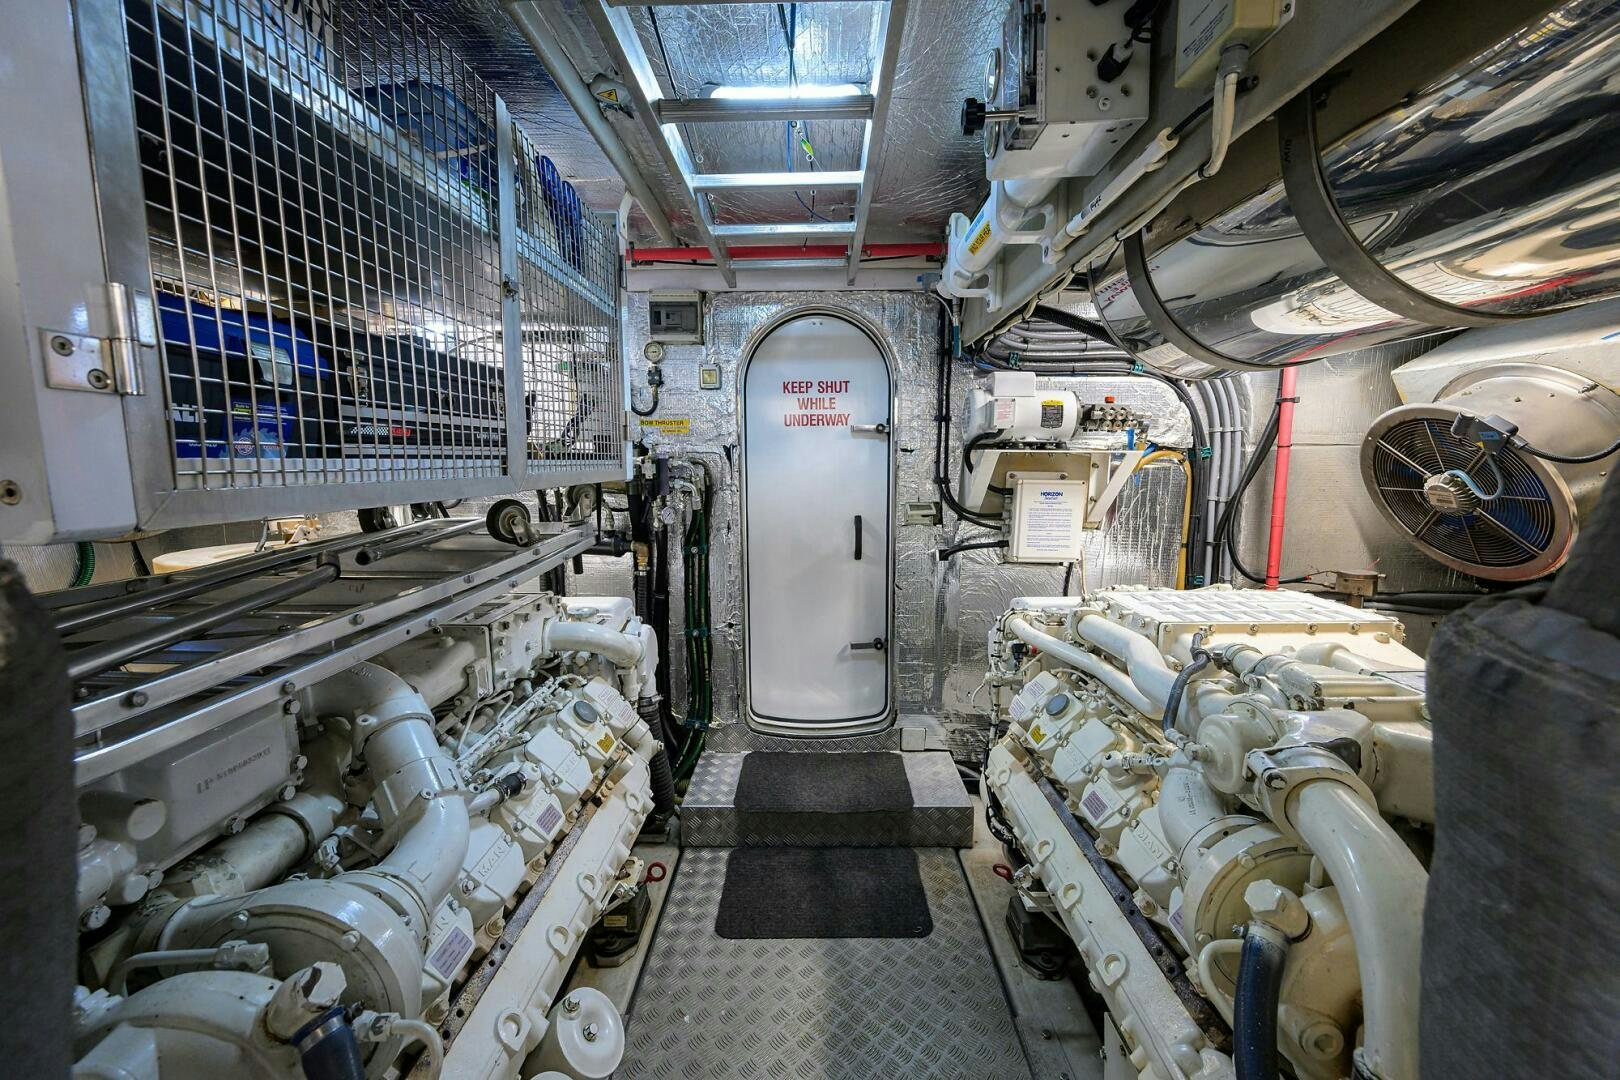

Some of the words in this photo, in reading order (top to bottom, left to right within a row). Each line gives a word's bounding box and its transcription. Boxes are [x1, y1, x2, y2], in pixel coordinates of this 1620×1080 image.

[783, 381, 813, 394] KEEP
[817, 381, 850, 394] SHUT
[798, 397, 836, 410] WHILE
[784, 414, 850, 427] UNDERWAY
